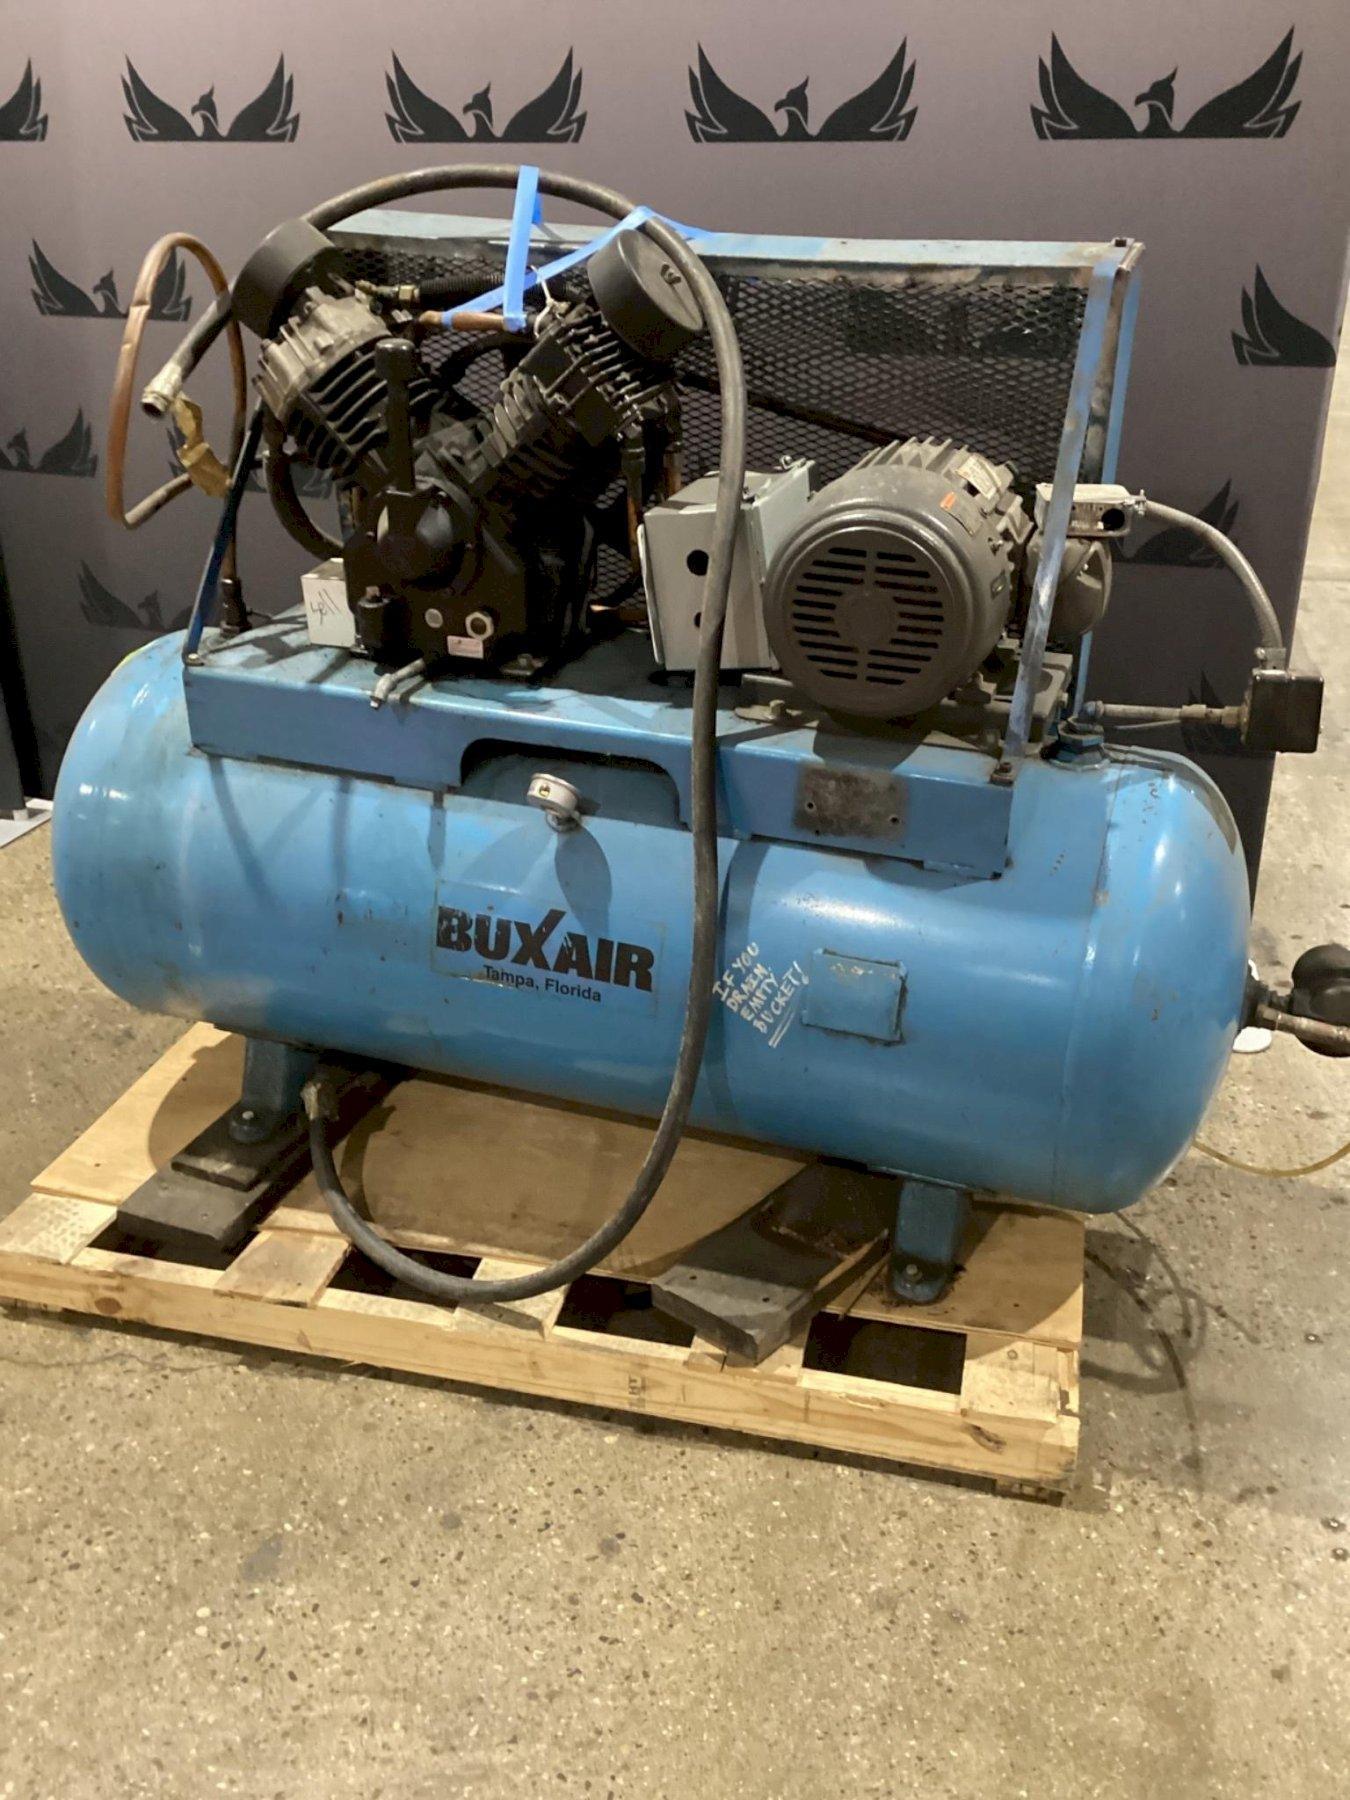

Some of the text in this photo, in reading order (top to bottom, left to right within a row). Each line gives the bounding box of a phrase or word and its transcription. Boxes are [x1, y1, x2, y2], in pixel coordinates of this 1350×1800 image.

[436, 907, 655, 992] BUXAIR
[712, 942, 759, 1002] IF YOU
[483, 964, 602, 1002] Tampa, Florida
[740, 972, 779, 1021] EMPTY
[753, 960, 810, 1034] BUCKET!
